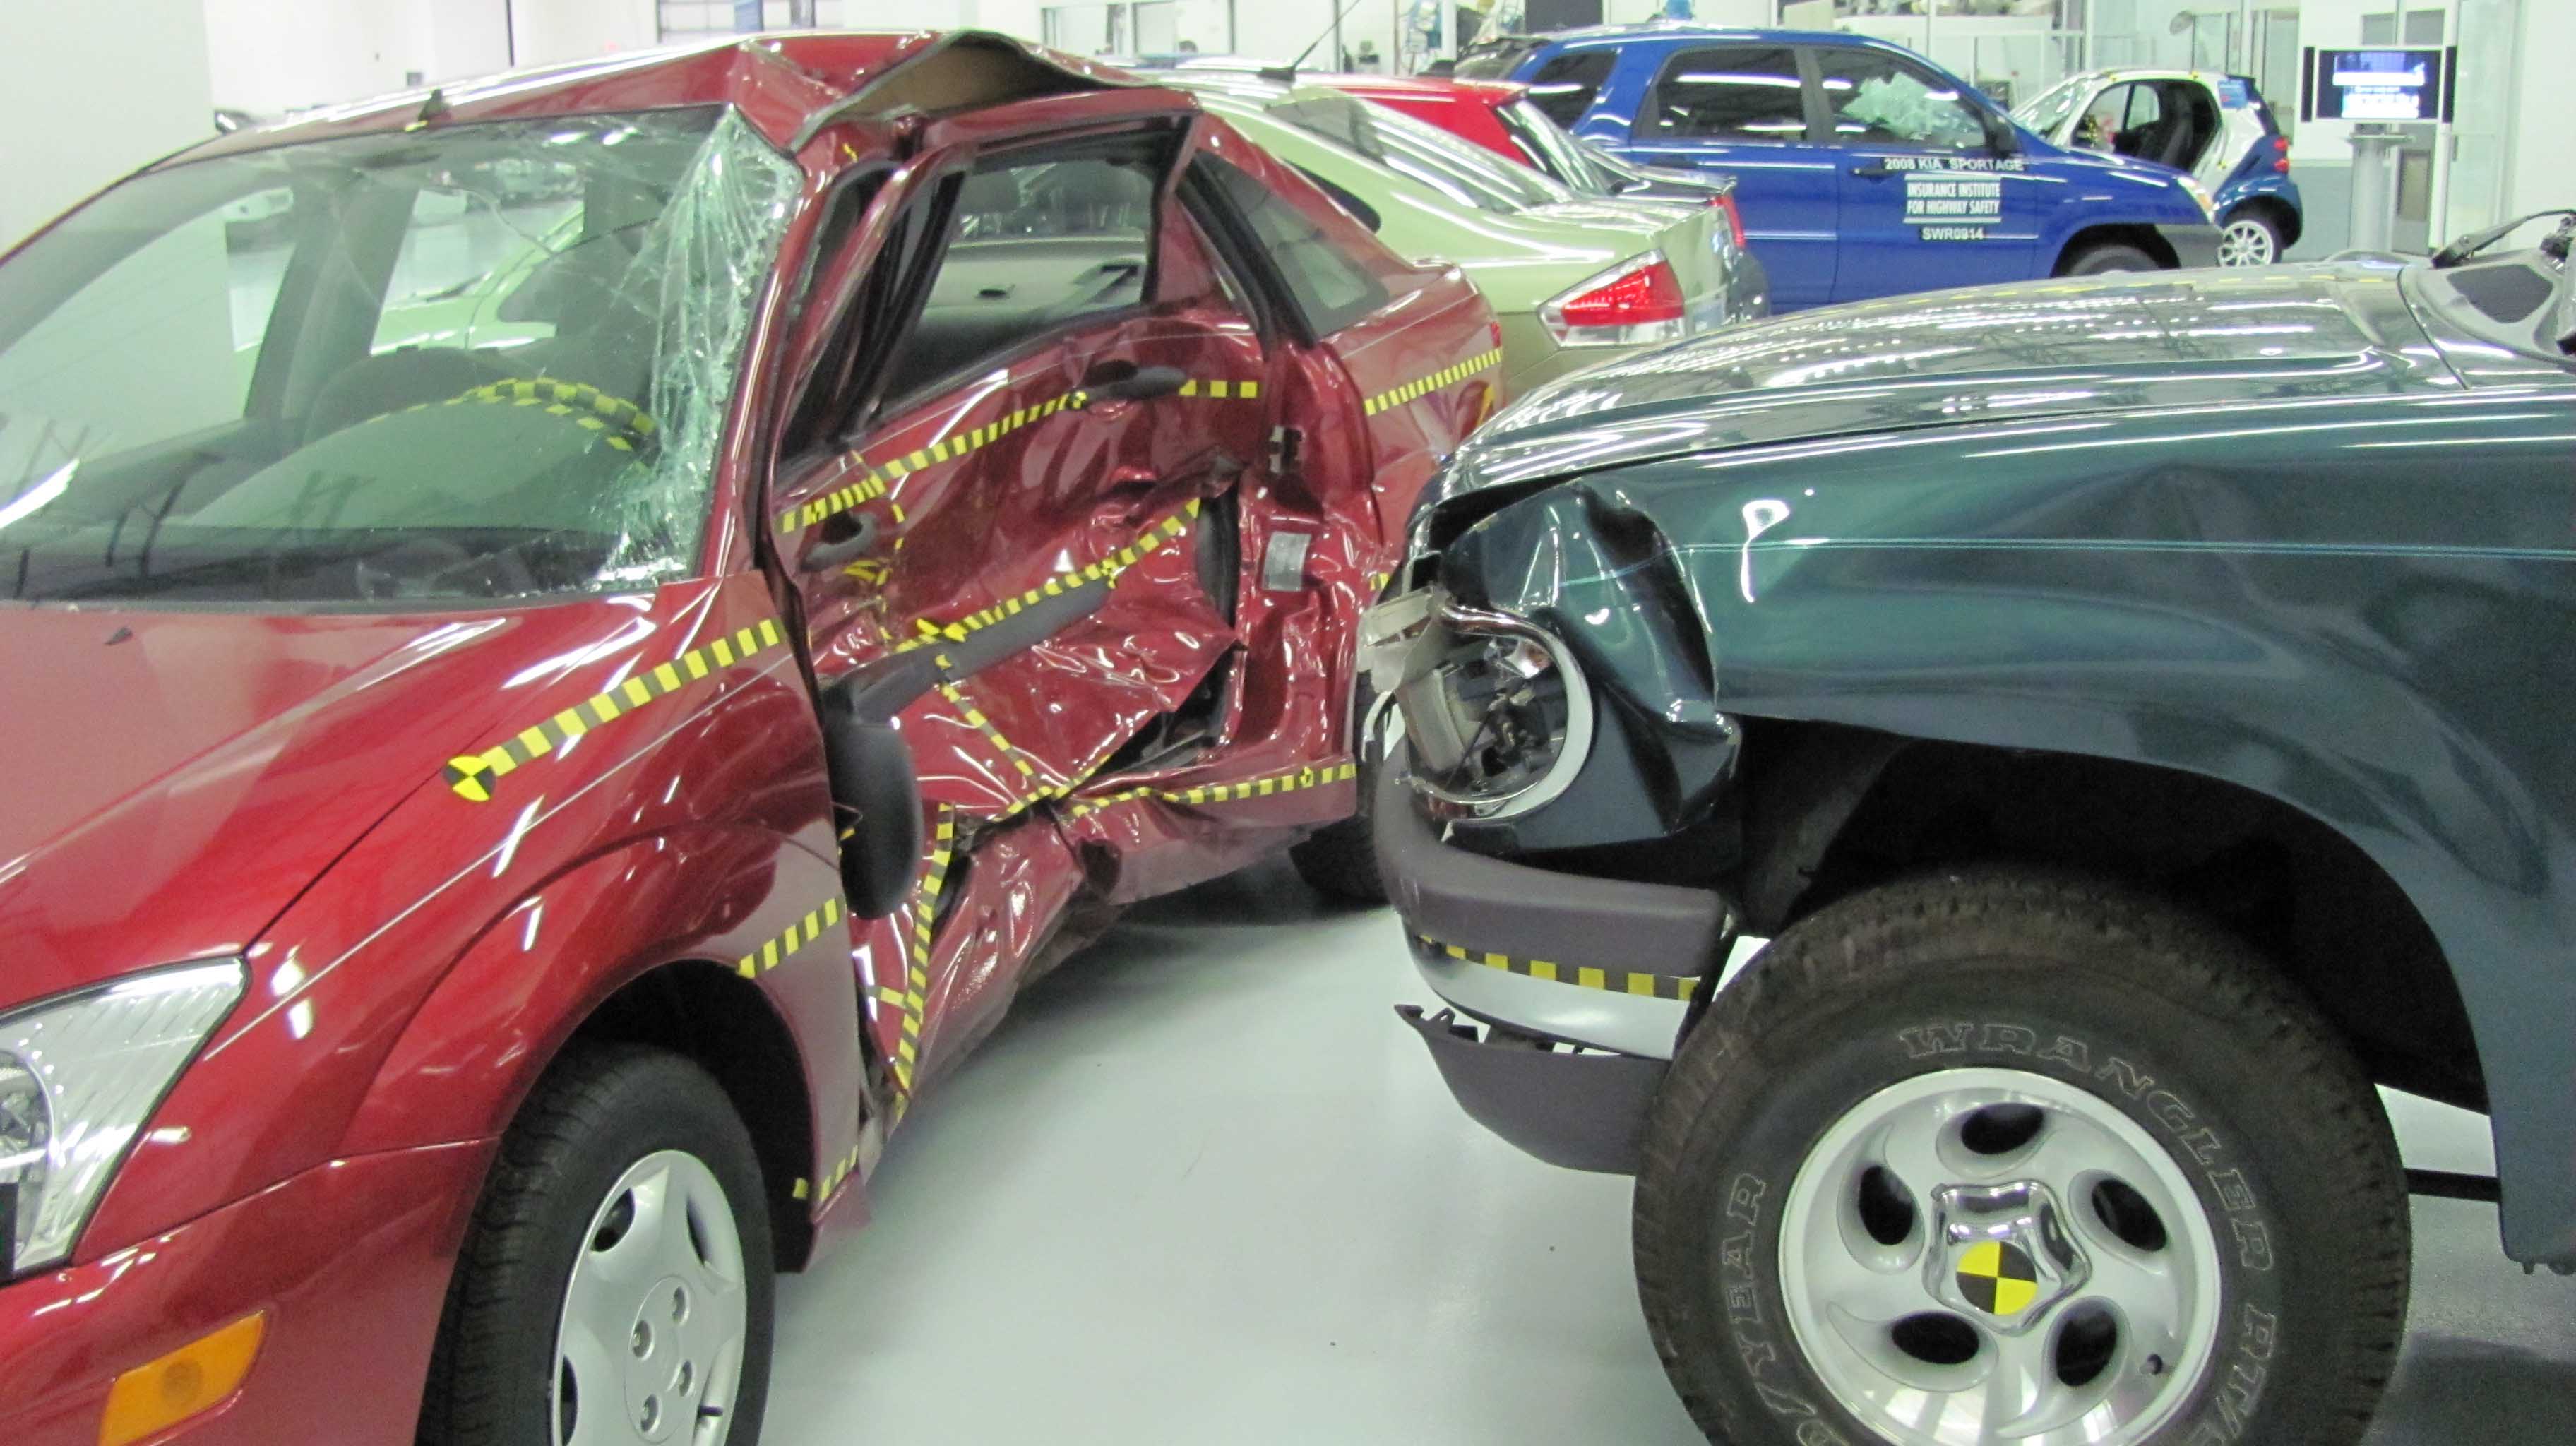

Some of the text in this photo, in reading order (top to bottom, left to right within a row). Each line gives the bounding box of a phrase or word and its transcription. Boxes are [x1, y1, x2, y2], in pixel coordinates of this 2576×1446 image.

[1918, 159, 1943, 169] KIA
[1949, 158, 2024, 171] SPORTAGE
[1907, 183, 2000, 198] INSURANCE INSTITUTE
[1907, 200, 2000, 215] FOR HIGHWAY SAFETY
[1899, 1023, 2273, 1271] WRANGLER
